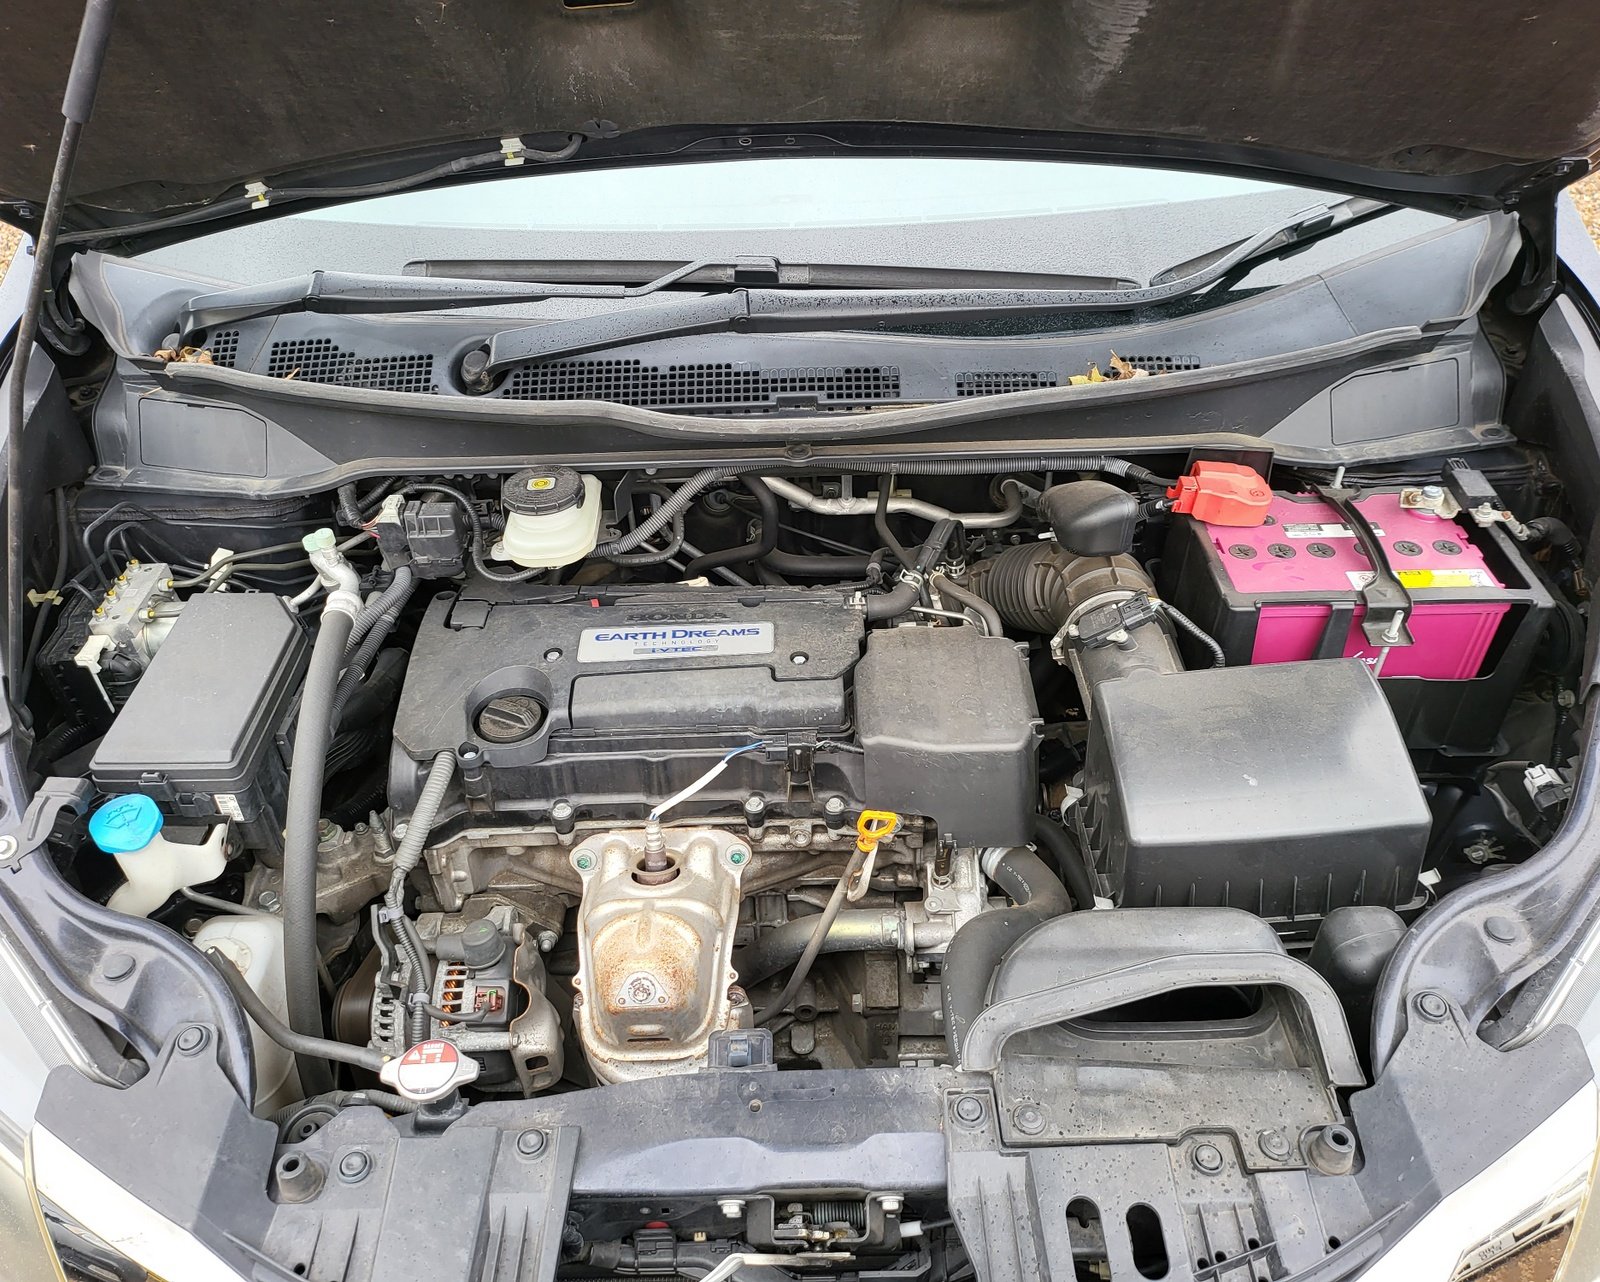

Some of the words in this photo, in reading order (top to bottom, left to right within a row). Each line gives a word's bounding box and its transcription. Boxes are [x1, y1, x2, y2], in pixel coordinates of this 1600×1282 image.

[625, 612, 731, 622] HONDA
[595, 631, 666, 641] EARTH
[672, 628, 760, 638] DREAMS
